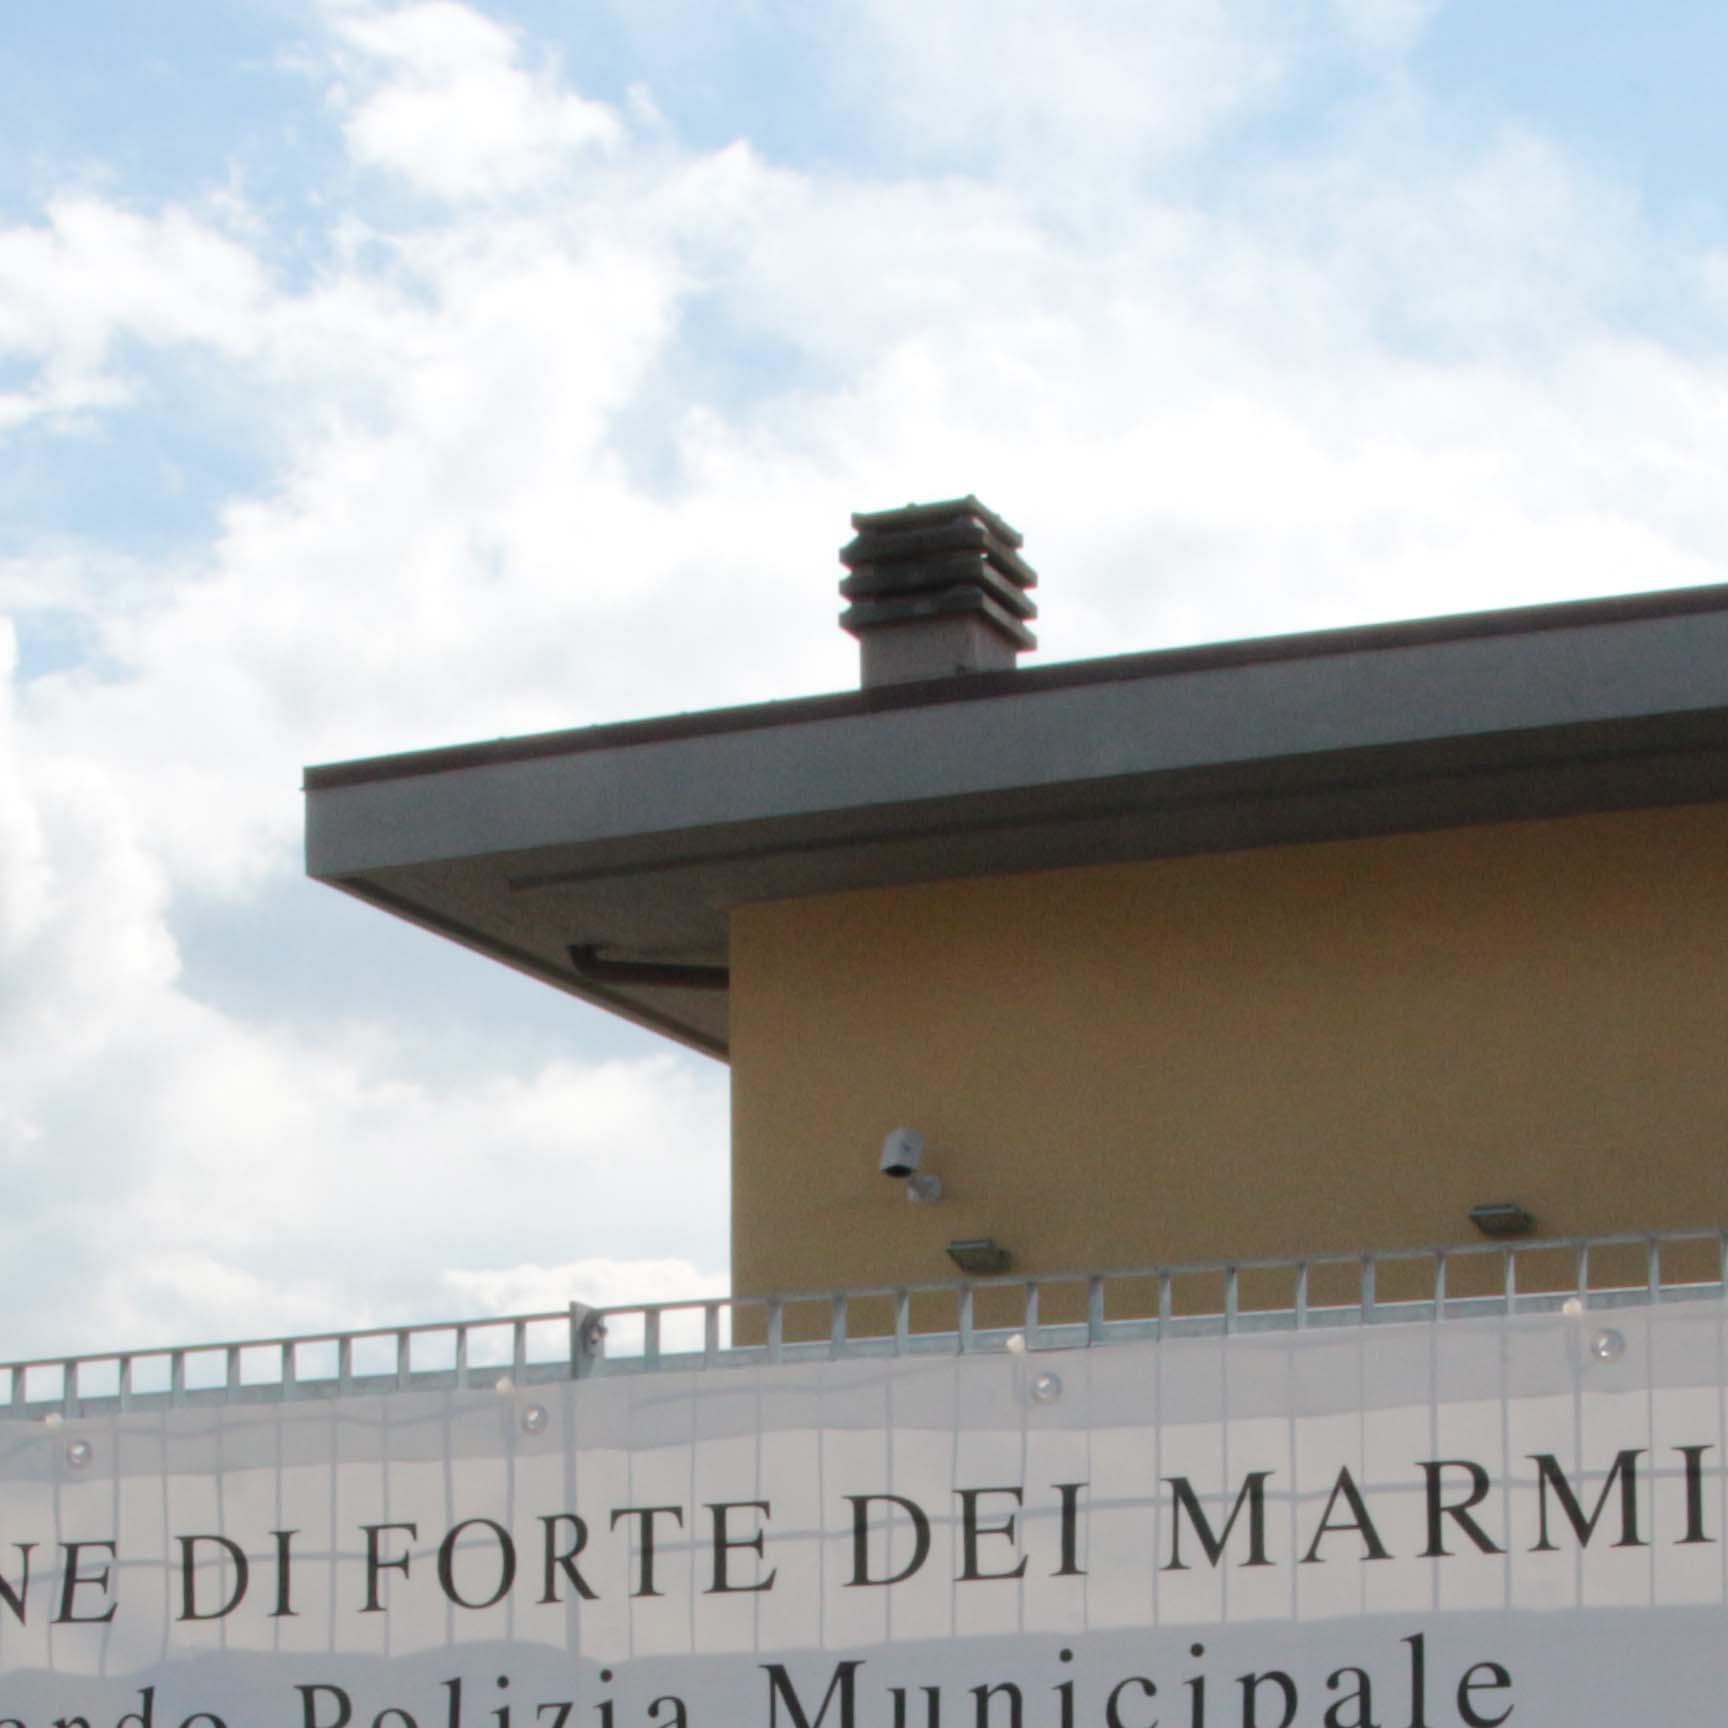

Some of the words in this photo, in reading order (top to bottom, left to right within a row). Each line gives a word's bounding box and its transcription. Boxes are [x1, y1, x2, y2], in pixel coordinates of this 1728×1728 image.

[175, 1529, 302, 1623] DI
[359, 1498, 777, 1614] FORTE
[842, 1482, 1090, 1589] DEI
[1160, 1444, 1719, 1571] MARMI
